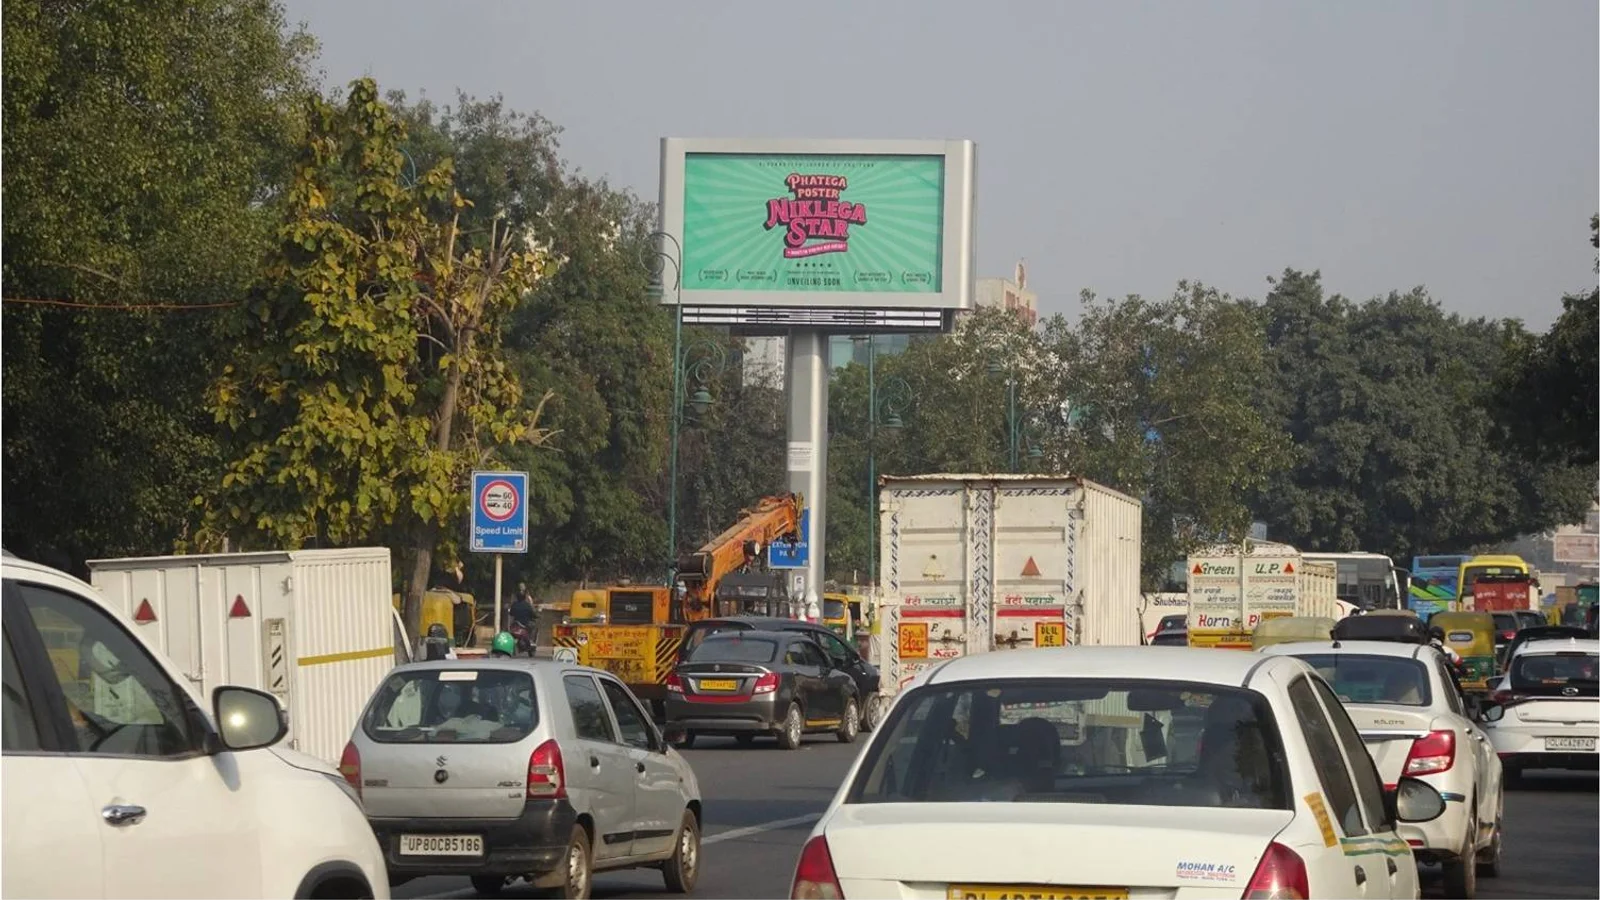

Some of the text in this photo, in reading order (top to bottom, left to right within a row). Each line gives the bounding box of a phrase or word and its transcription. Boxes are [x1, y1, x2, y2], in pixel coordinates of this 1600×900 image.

[786, 173, 847, 189] PHATEGA
[797, 188, 839, 198] POSTER
[767, 198, 866, 227] NIKLEGA
[787, 217, 849, 245] STAR
[787, 277, 841, 286] UNVEILING SOON
[476, 526, 523, 536] Speed Limit
[1200, 562, 1281, 575] Green U.P.
[1198, 614, 1230, 627] Horn
[408, 838, 480, 852] UP80CB5186
[1177, 862, 1235, 873] MOHAN A/C
